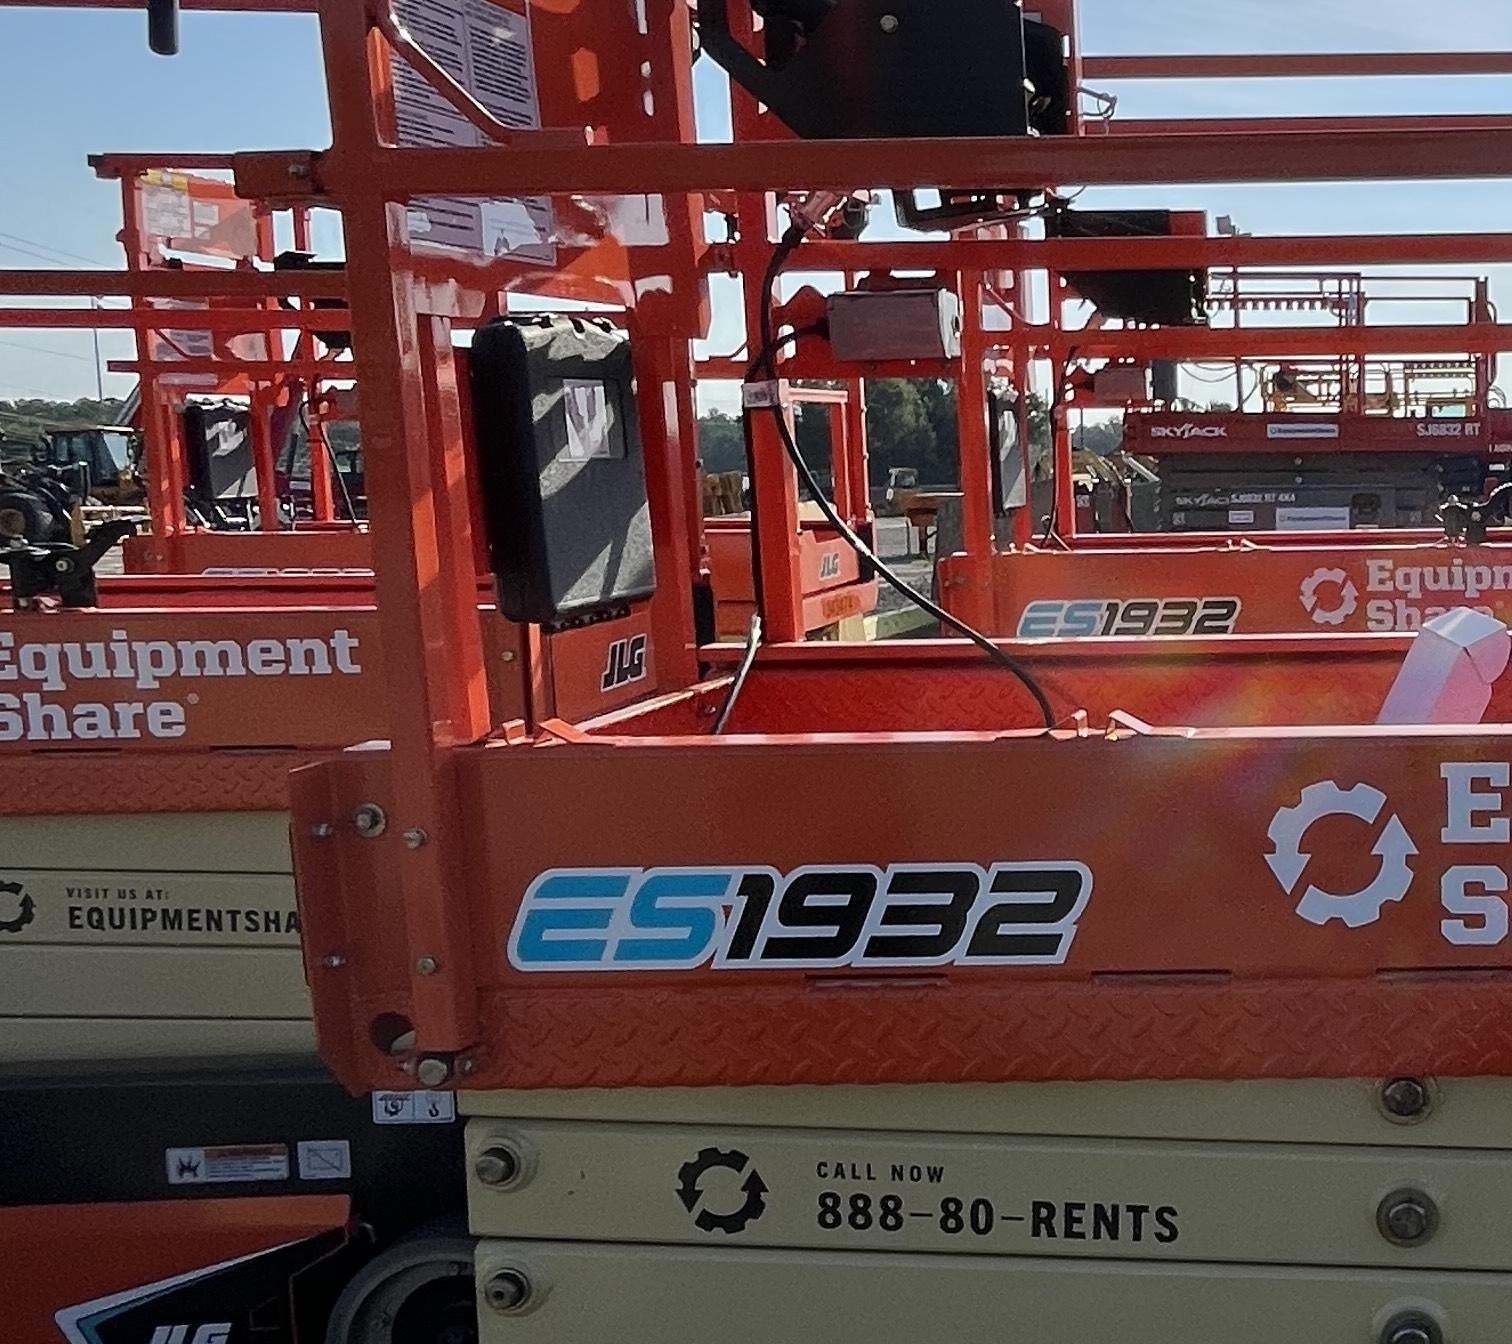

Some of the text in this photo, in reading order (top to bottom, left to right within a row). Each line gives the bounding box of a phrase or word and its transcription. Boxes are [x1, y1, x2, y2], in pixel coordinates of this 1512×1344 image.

[1151, 423, 1227, 439] SKYJACK
[1018, 601, 1240, 636] ES1932
[602, 635, 646, 690] JLG
[66, 887, 169, 901] VISIT US AT:
[512, 865, 1086, 967] ES1932
[816, 1161, 946, 1184] CALL NOW
[816, 1191, 1180, 1244] 888-80-RENTS
